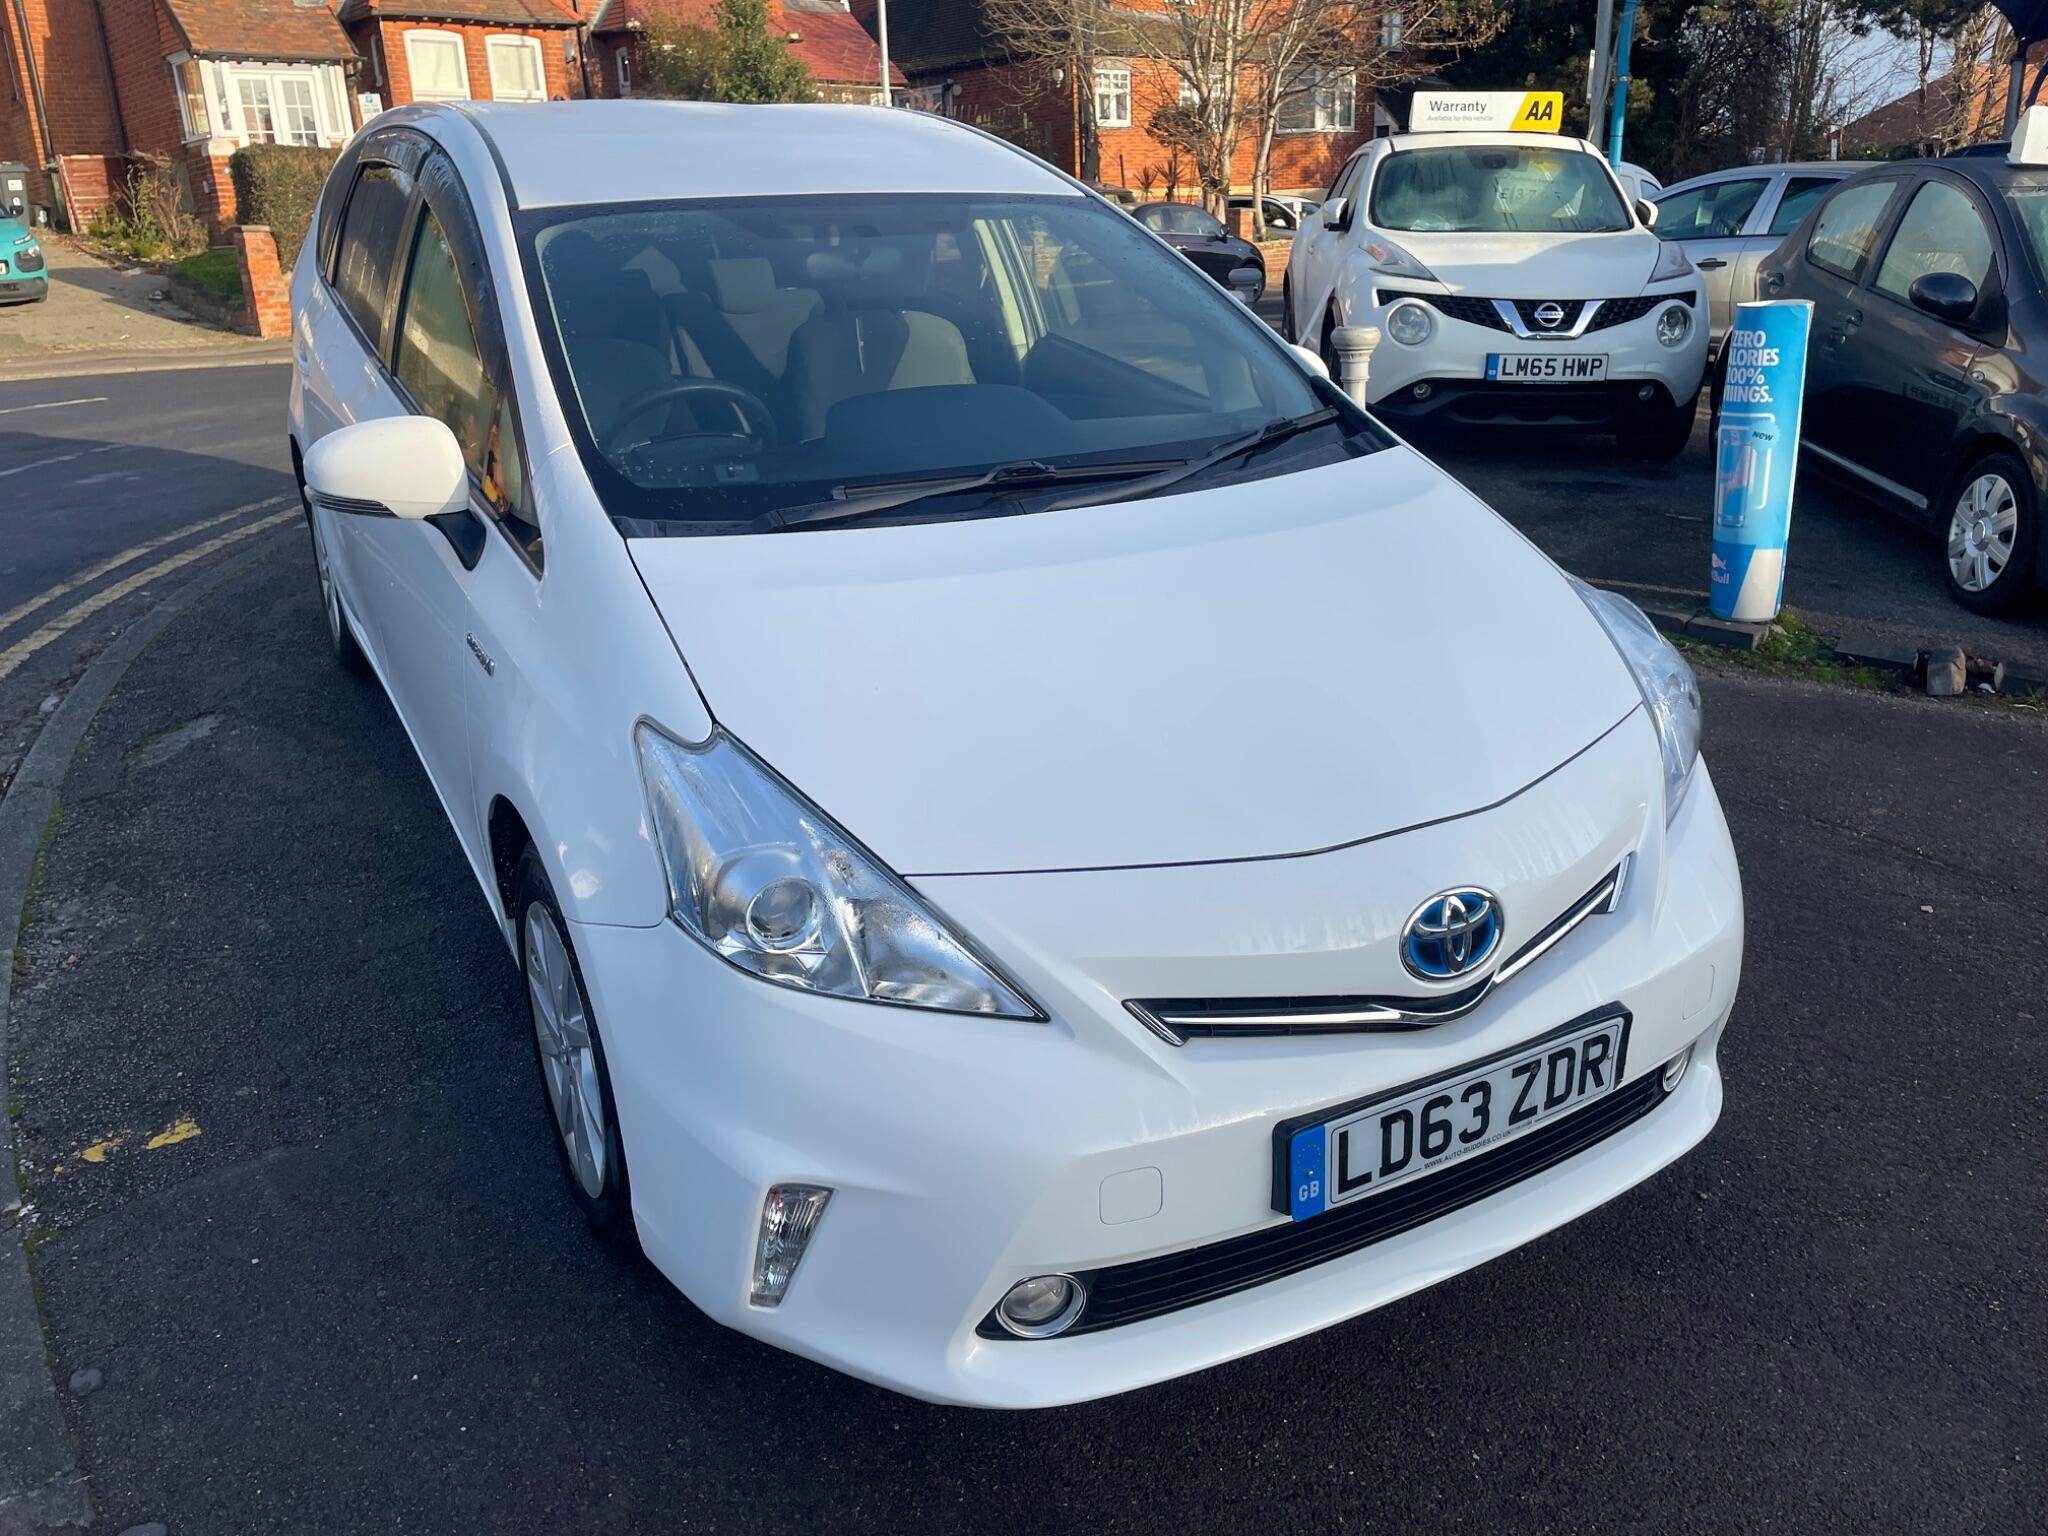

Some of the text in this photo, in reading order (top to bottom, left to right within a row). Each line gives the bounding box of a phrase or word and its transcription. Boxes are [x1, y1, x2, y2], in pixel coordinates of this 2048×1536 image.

[1429, 100, 1487, 114] Warranty
[1525, 101, 1553, 121] AA
[1732, 330, 1766, 348] ZERO
[1501, 358, 1603, 377] LM65 HWP
[1337, 1033, 1611, 1194] LD63 ZDR
[1299, 1181, 1319, 1201] GB
